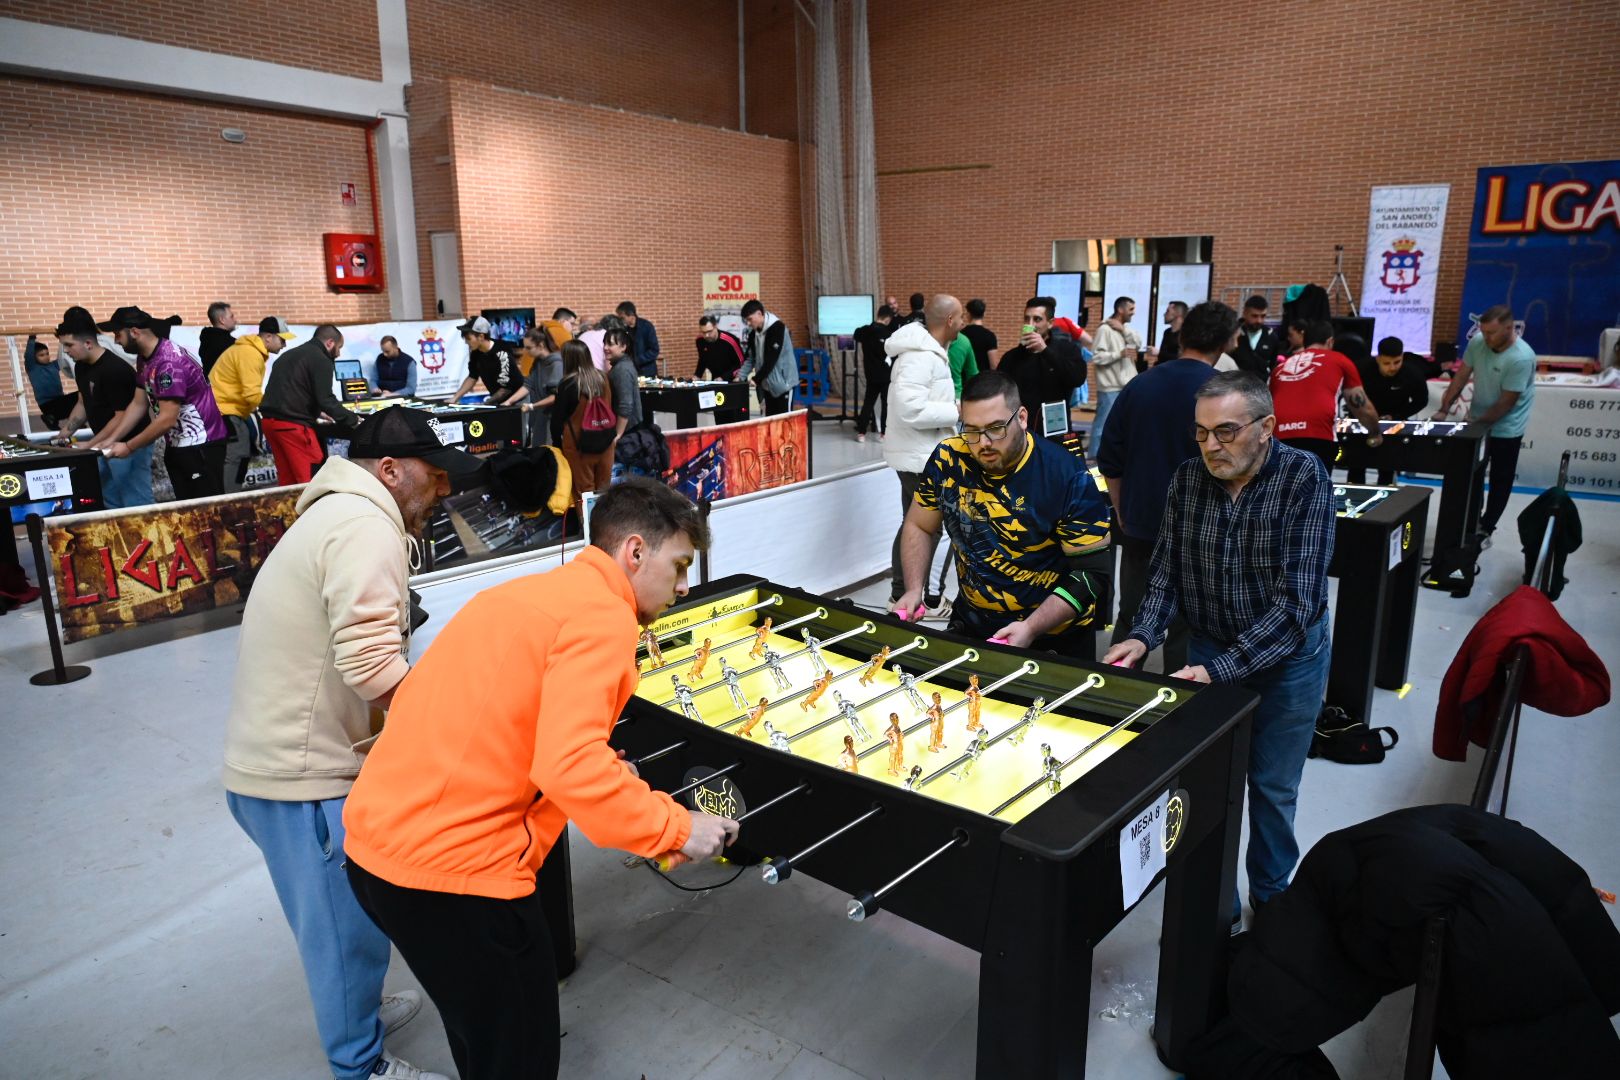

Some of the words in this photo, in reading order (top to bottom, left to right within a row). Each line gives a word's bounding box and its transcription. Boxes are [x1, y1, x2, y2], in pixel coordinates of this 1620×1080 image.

[1391, 221, 1438, 229] RABANEDO
[718, 274, 743, 292] 30
[1569, 399, 1595, 409] 686
[1278, 421, 1307, 431] BARCI
[1566, 427, 1592, 437] 605
[1595, 428, 1620, 439] 373
[1591, 451, 1617, 462] 683
[32, 474, 54, 482] MESA
[1566, 475, 1585, 485] 39
[1590, 476, 1613, 488] 101
[1130, 811, 1154, 841] MESA
[1155, 805, 1161, 819] 8
